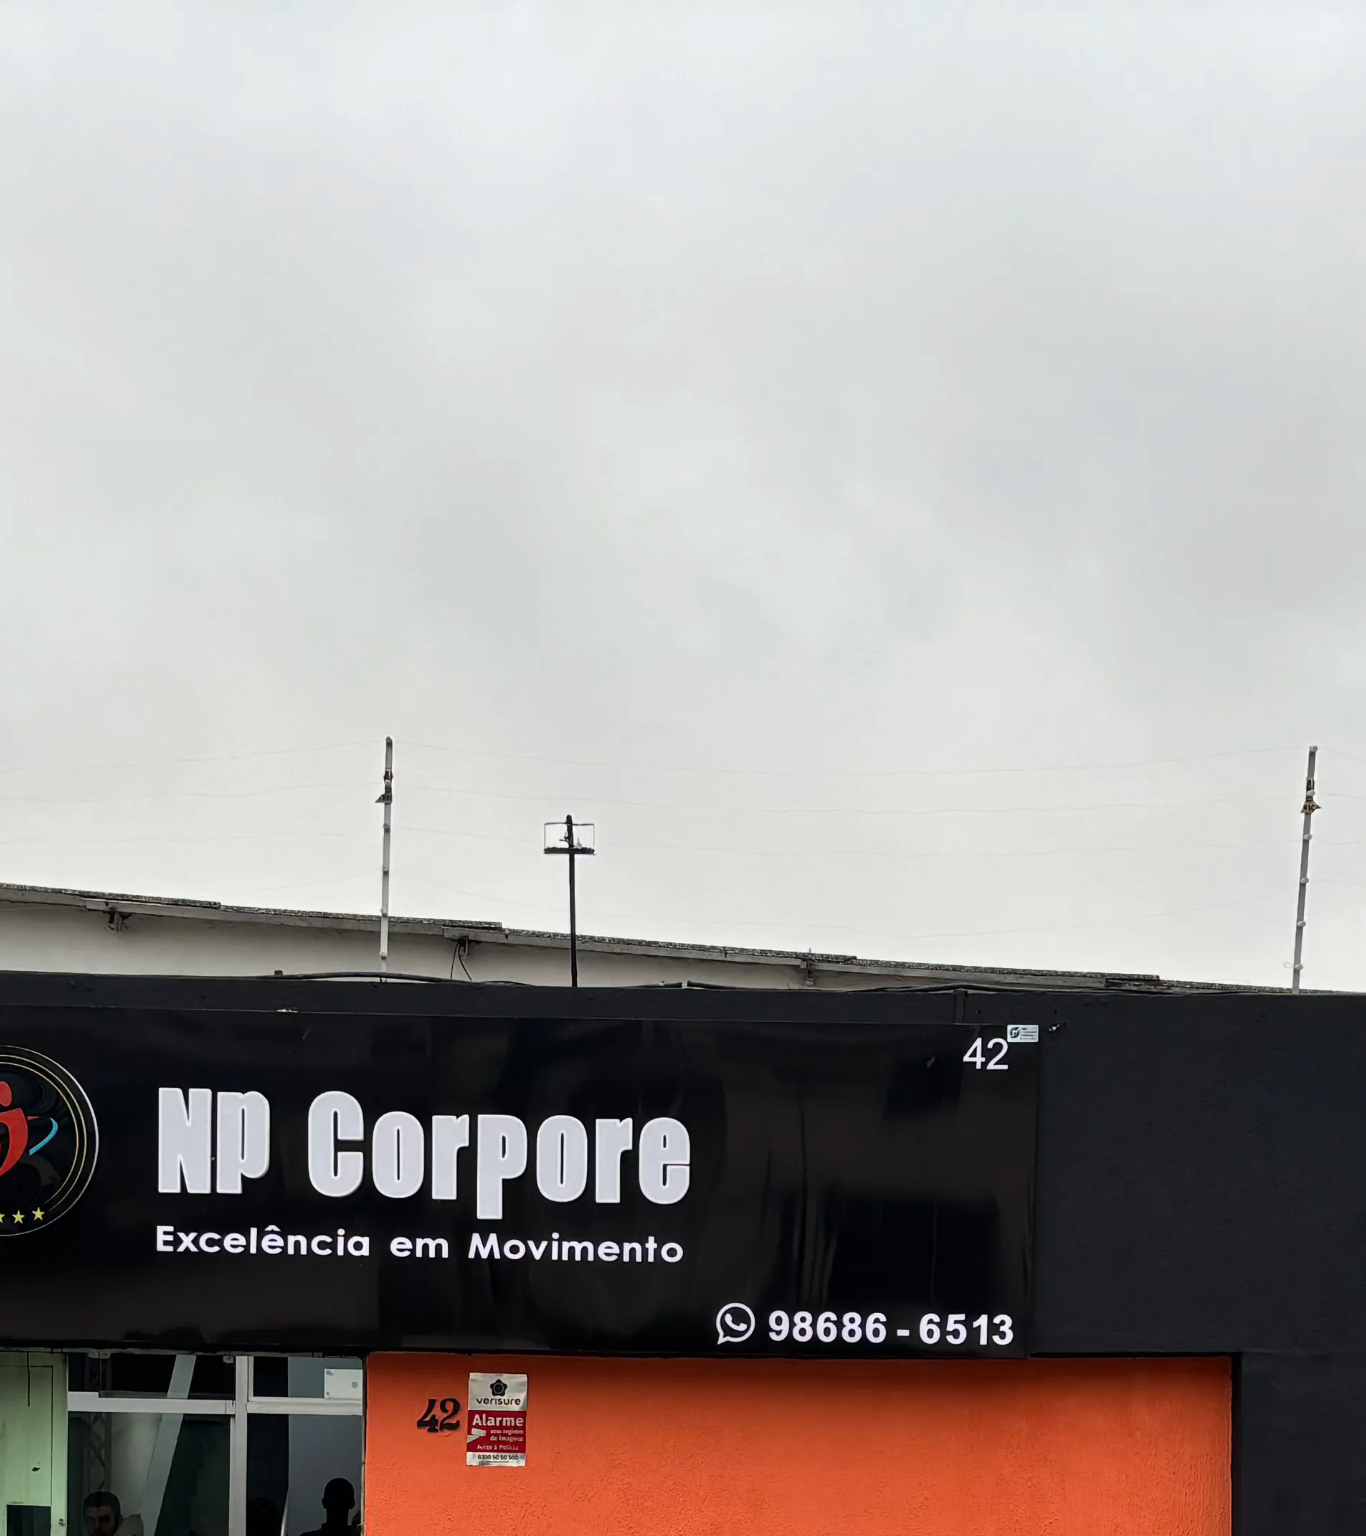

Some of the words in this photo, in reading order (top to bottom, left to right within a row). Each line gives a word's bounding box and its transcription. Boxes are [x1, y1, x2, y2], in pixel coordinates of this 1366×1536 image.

[962, 1037, 1009, 1070] 42
[308, 1090, 691, 1220] Corpore
[156, 1224, 370, 1257] Excelência
[389, 1236, 449, 1259] em
[467, 1232, 684, 1263] Movimento
[768, 1310, 887, 1344] 98686
[919, 1313, 1014, 1346] 6513
[416, 1398, 461, 1433] 42
[476, 1397, 521, 1405] verisure
[473, 1414, 524, 1426] Alarme
